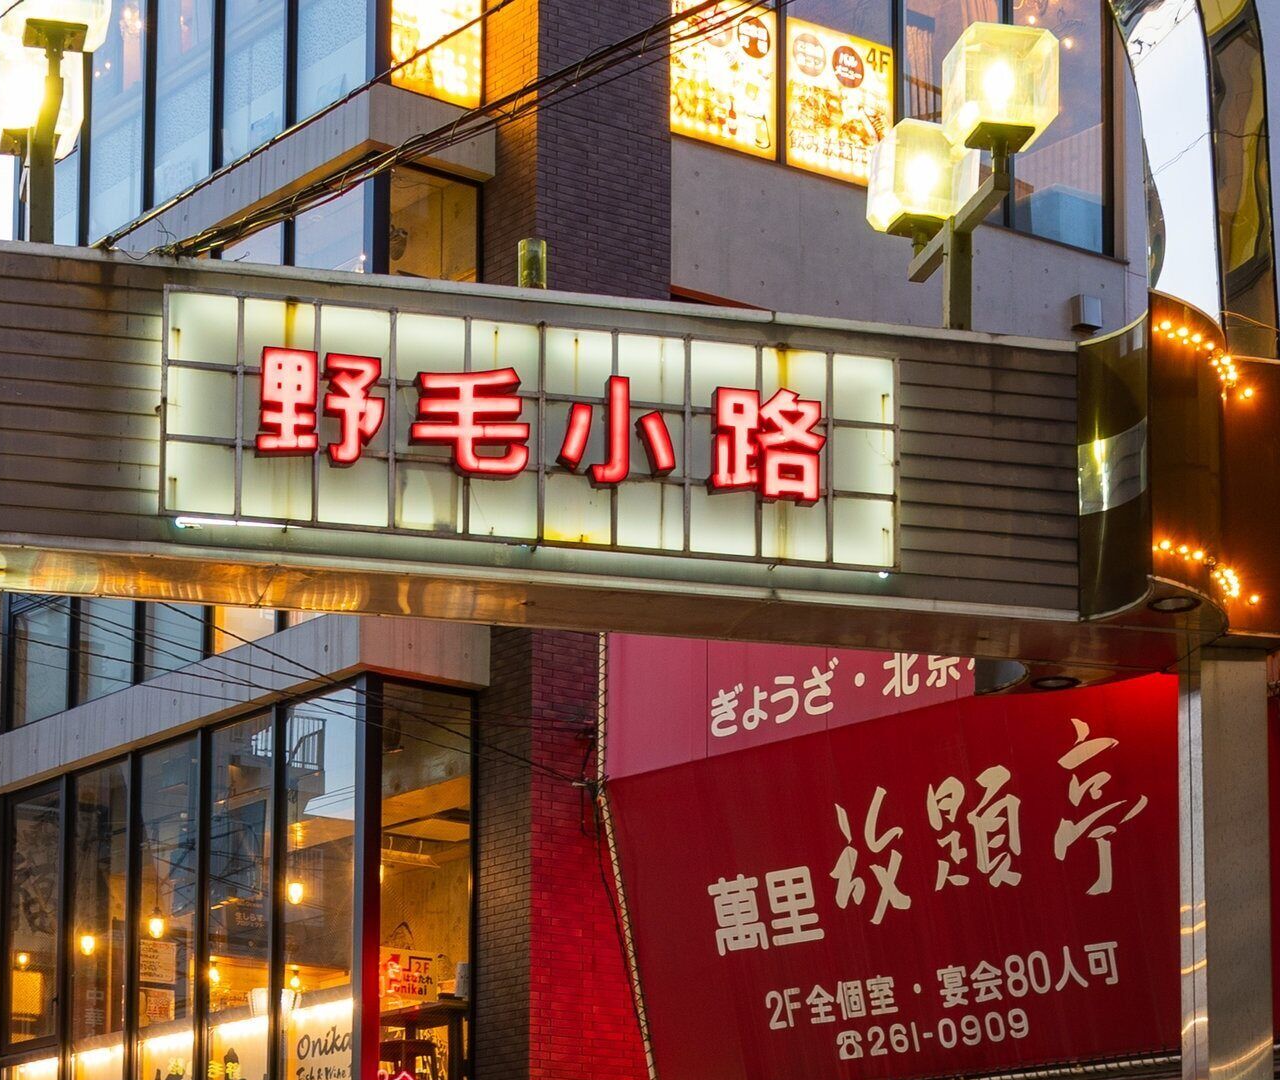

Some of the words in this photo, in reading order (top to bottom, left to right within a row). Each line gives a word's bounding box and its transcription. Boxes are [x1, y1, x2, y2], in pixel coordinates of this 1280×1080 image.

[866, 48, 891, 73] 4F
[256, 346, 826, 507] 野毛小路
[710, 653, 975, 737] ぎょうざ・北京
[708, 865, 824, 956] 萬里
[830, 718, 1148, 925] 放題亭
[765, 941, 1119, 1030] 2F全個室・宴会80人可
[866, 1008, 1030, 1057] 261-0909
